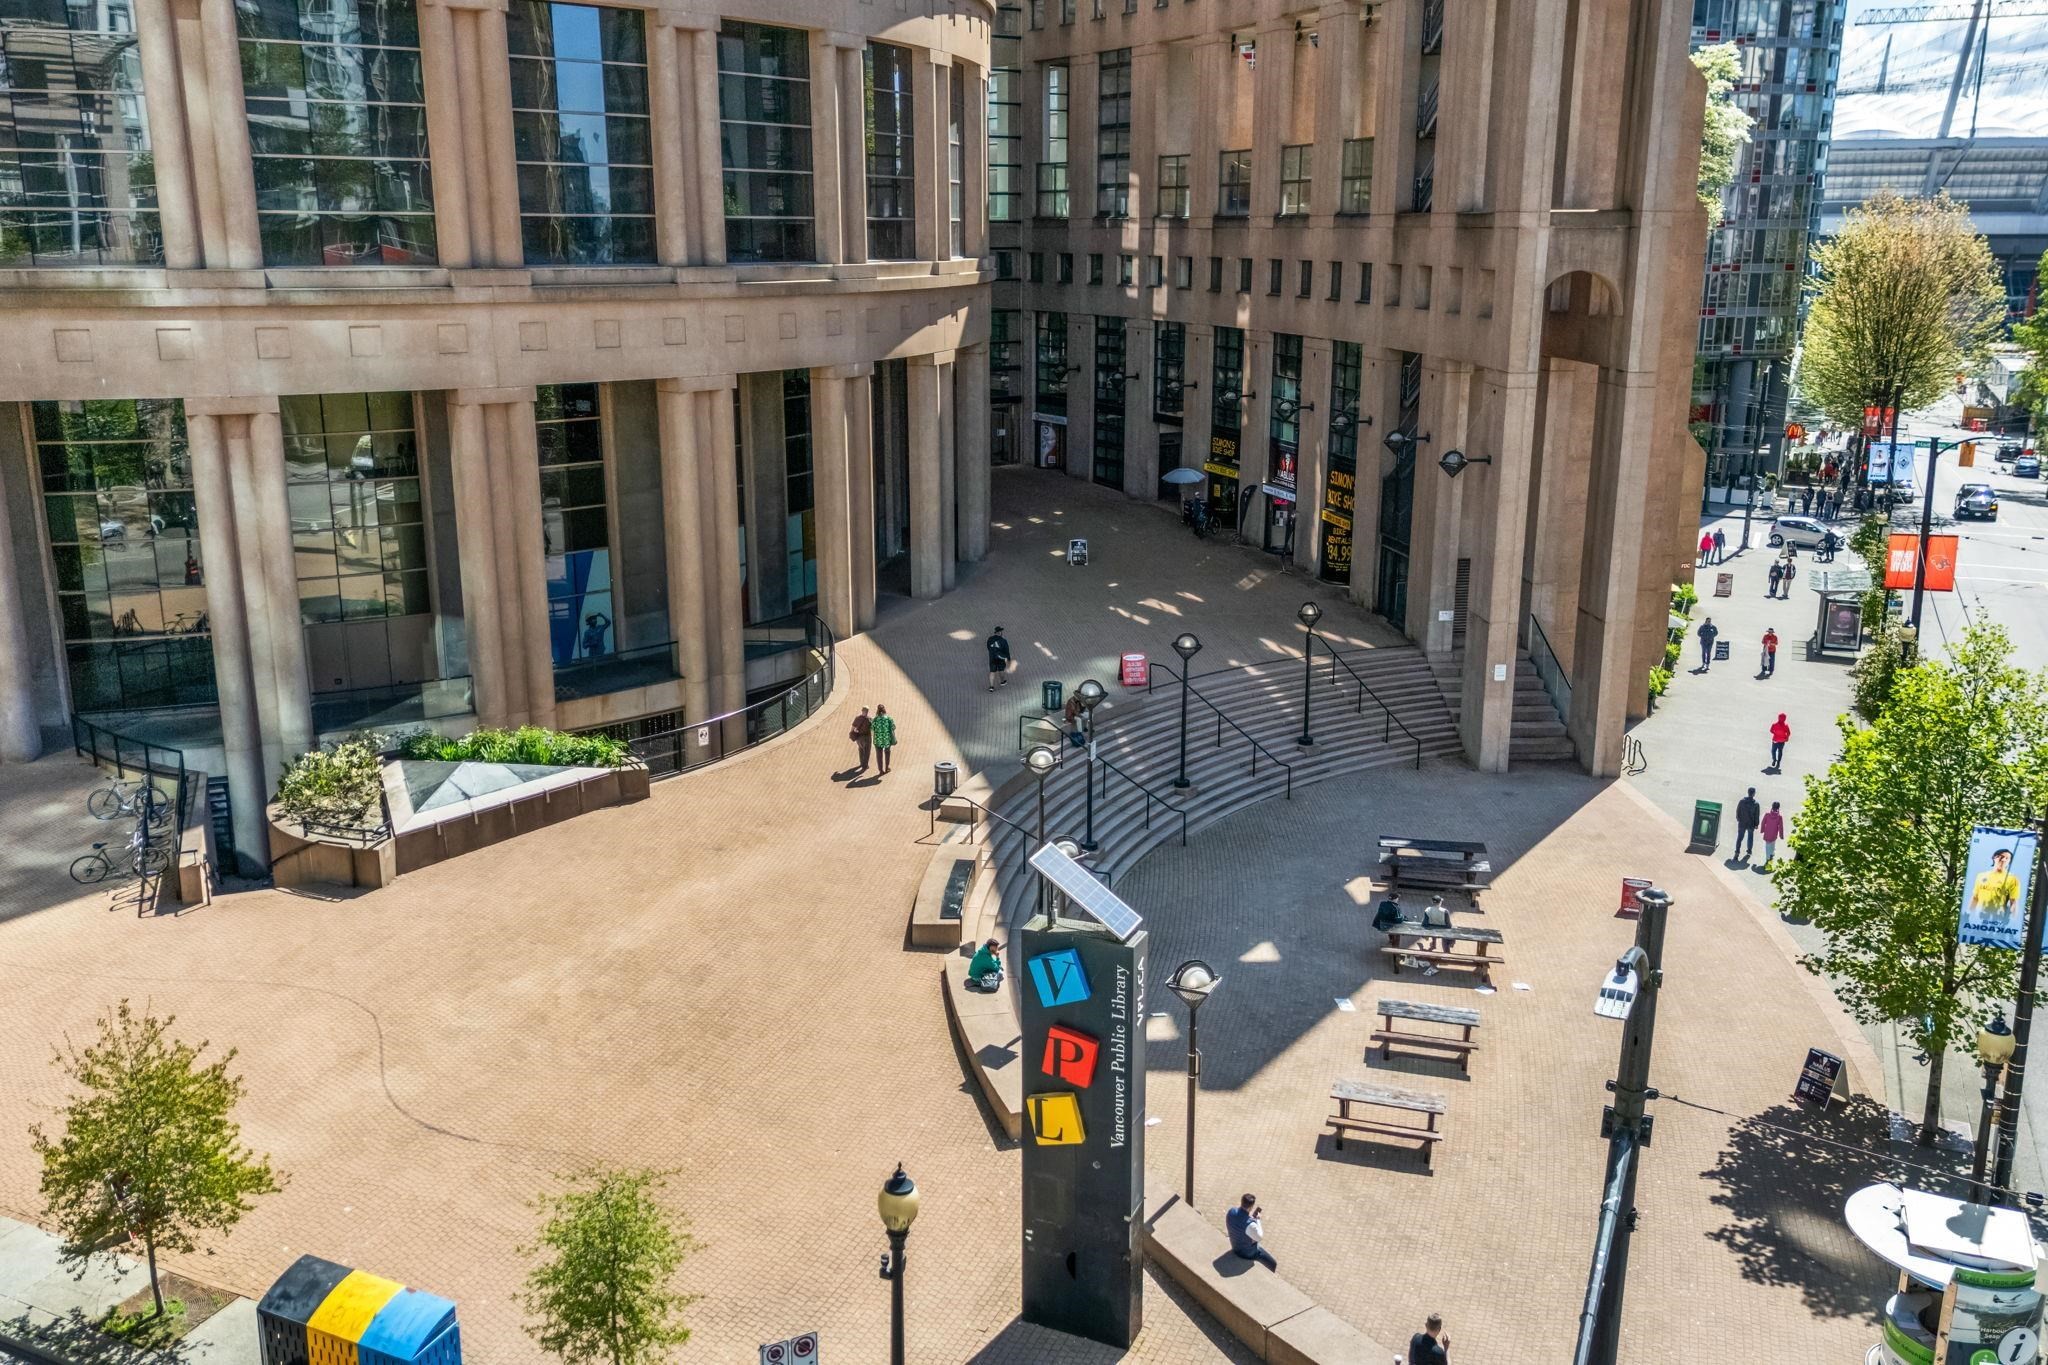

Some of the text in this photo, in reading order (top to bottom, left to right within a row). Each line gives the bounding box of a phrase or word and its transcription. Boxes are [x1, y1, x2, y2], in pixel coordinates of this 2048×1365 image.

[1327, 488, 1356, 511] BIKE SHO
[1330, 470, 1355, 490] SIMON'
[1040, 957, 1076, 1003] V
[1047, 1036, 1084, 1081] P
[1110, 964, 1130, 1149] Vancouver Public Library
[1034, 1098, 1063, 1142] L
[1983, 1333, 2001, 1341] Seap
